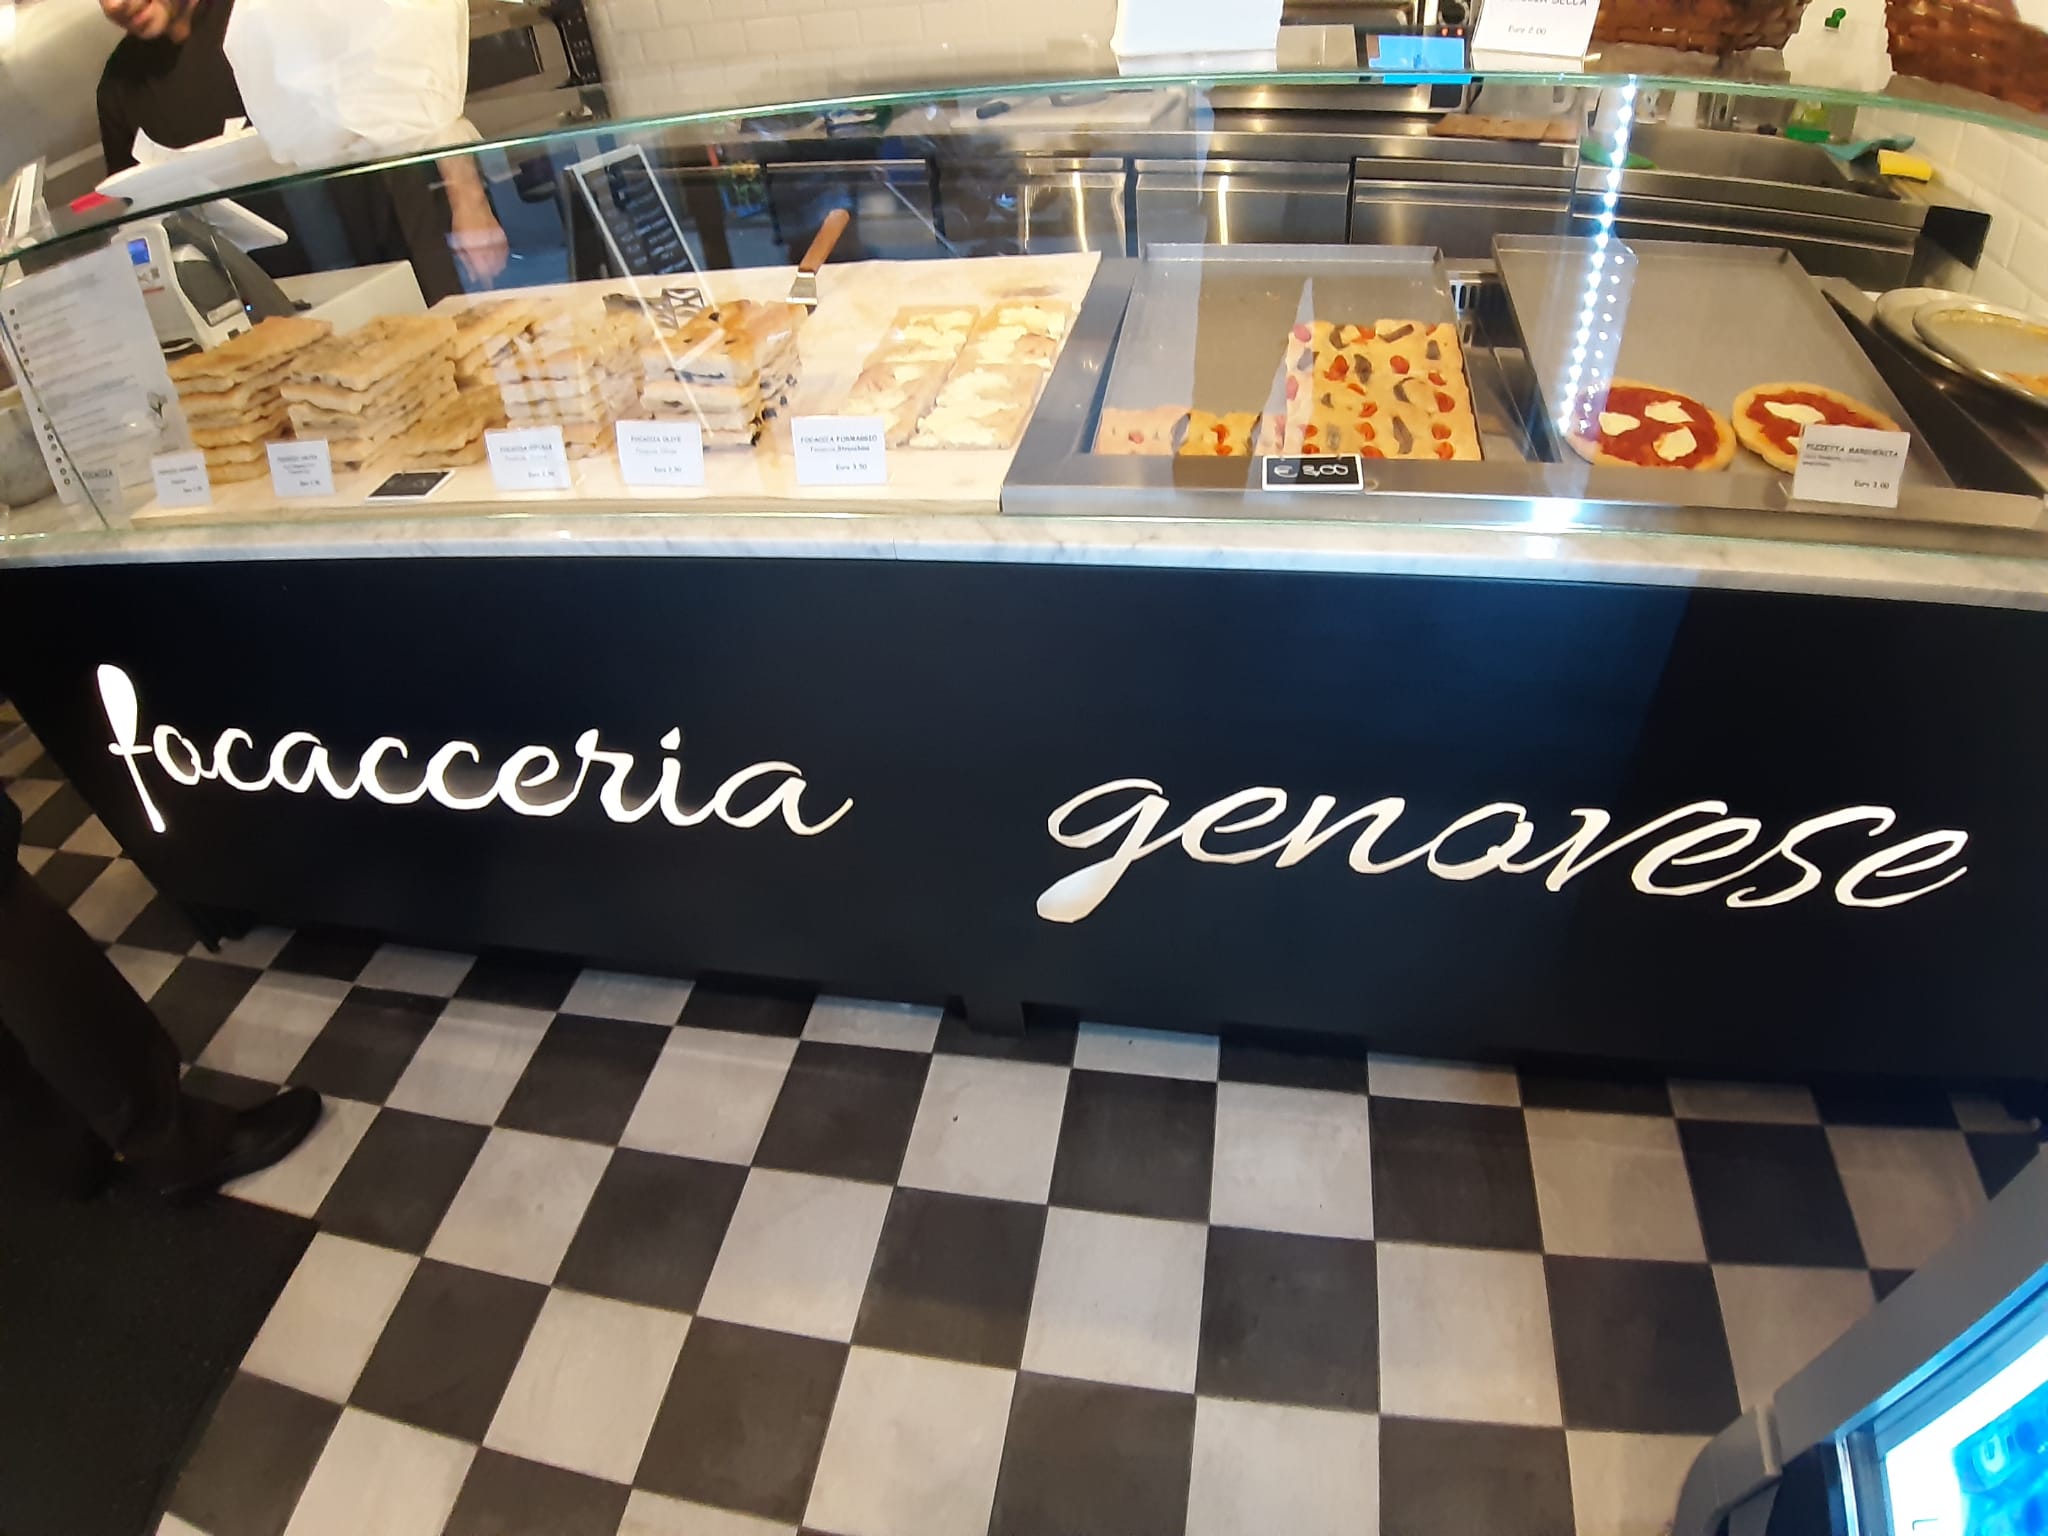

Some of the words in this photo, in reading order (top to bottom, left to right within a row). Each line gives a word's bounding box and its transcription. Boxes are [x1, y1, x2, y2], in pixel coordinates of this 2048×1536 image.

[1805, 443, 1845, 453] PIZZETTA
[1848, 446, 1898, 457] MARGHERITA
[97, 664, 853, 836] focacceria
[1036, 779, 1968, 923] genovese
